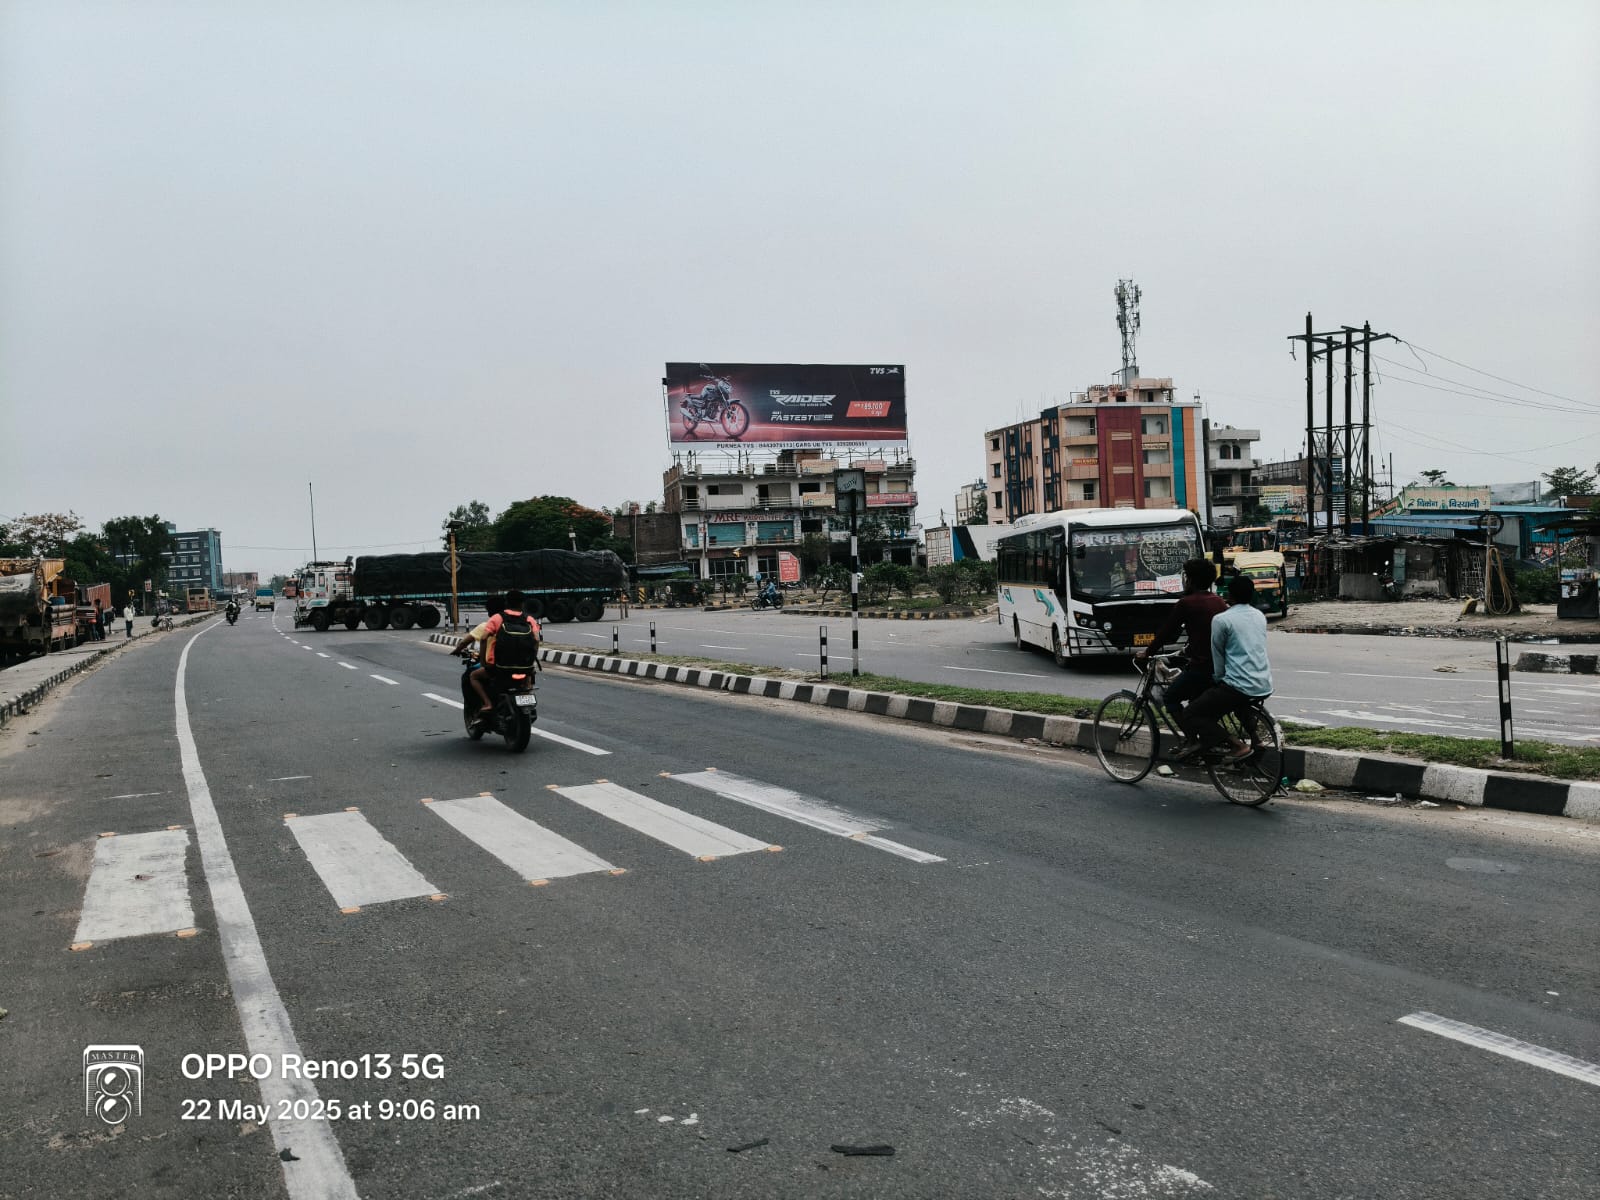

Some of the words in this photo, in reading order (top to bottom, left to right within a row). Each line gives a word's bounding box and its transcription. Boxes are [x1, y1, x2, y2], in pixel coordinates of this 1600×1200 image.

[869, 367, 885, 375] TVS
[769, 394, 837, 406] RAIDER
[770, 414, 814, 422] FASTEST
[714, 512, 743, 523] MRF
